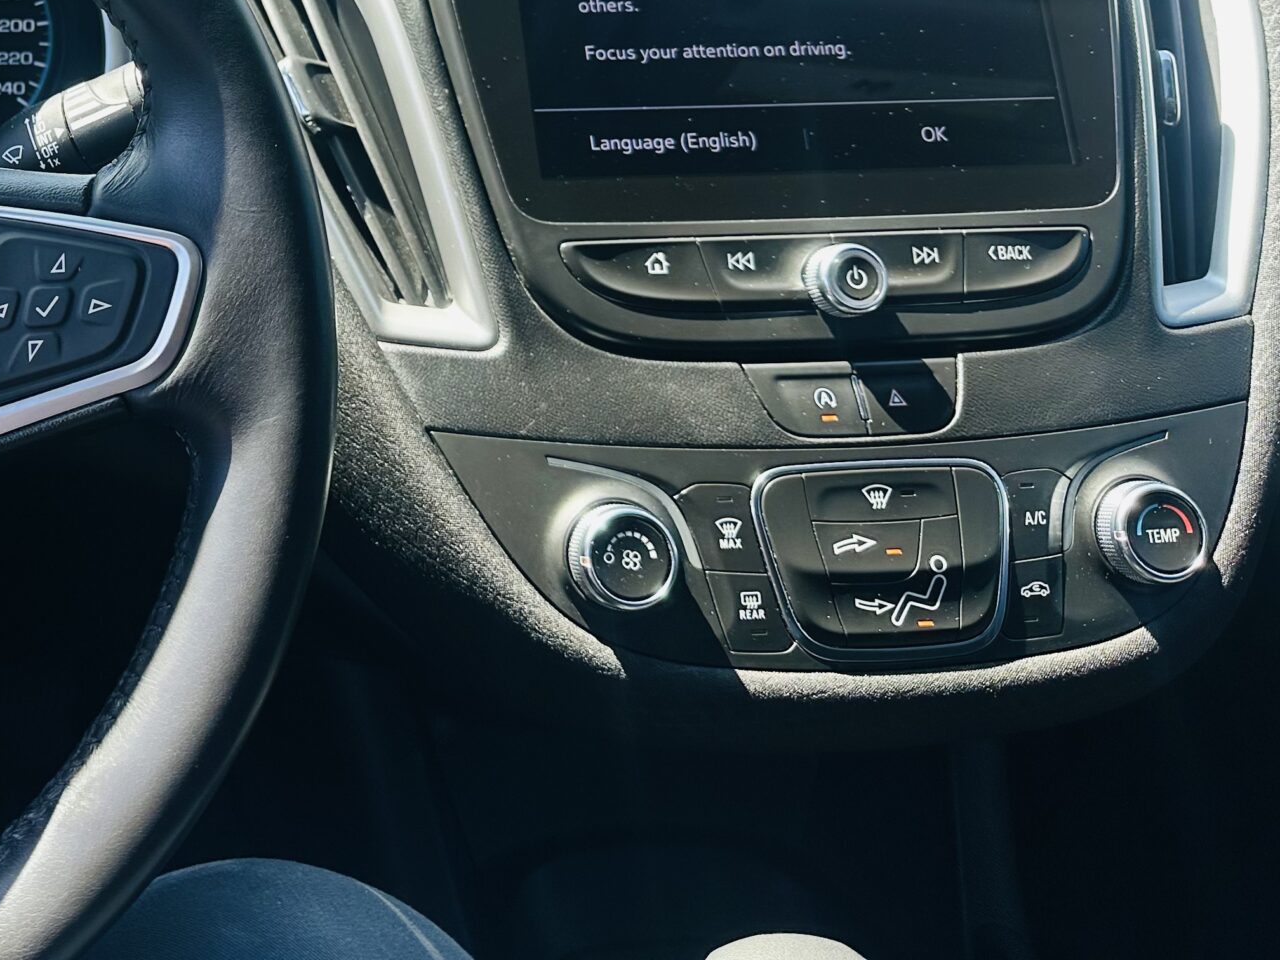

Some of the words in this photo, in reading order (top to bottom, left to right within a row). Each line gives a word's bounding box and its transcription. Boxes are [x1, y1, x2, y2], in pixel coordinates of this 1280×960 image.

[585, 45, 636, 61] Focus
[640, 46, 678, 63] your
[682, 42, 760, 58] attention
[763, 44, 786, 57] on
[789, 41, 852, 58] driving.
[921, 126, 948, 142] OK
[40, 141, 60, 159] OFF
[590, 135, 675, 154] Language
[680, 131, 757, 152] (English)
[47, 158, 61, 168] 1x
[997, 245, 1033, 261] BACK
[1024, 510, 1047, 526] A/C
[719, 538, 743, 550] MAX
[1145, 528, 1180, 544] TEMP
[739, 609, 766, 620] REAR
